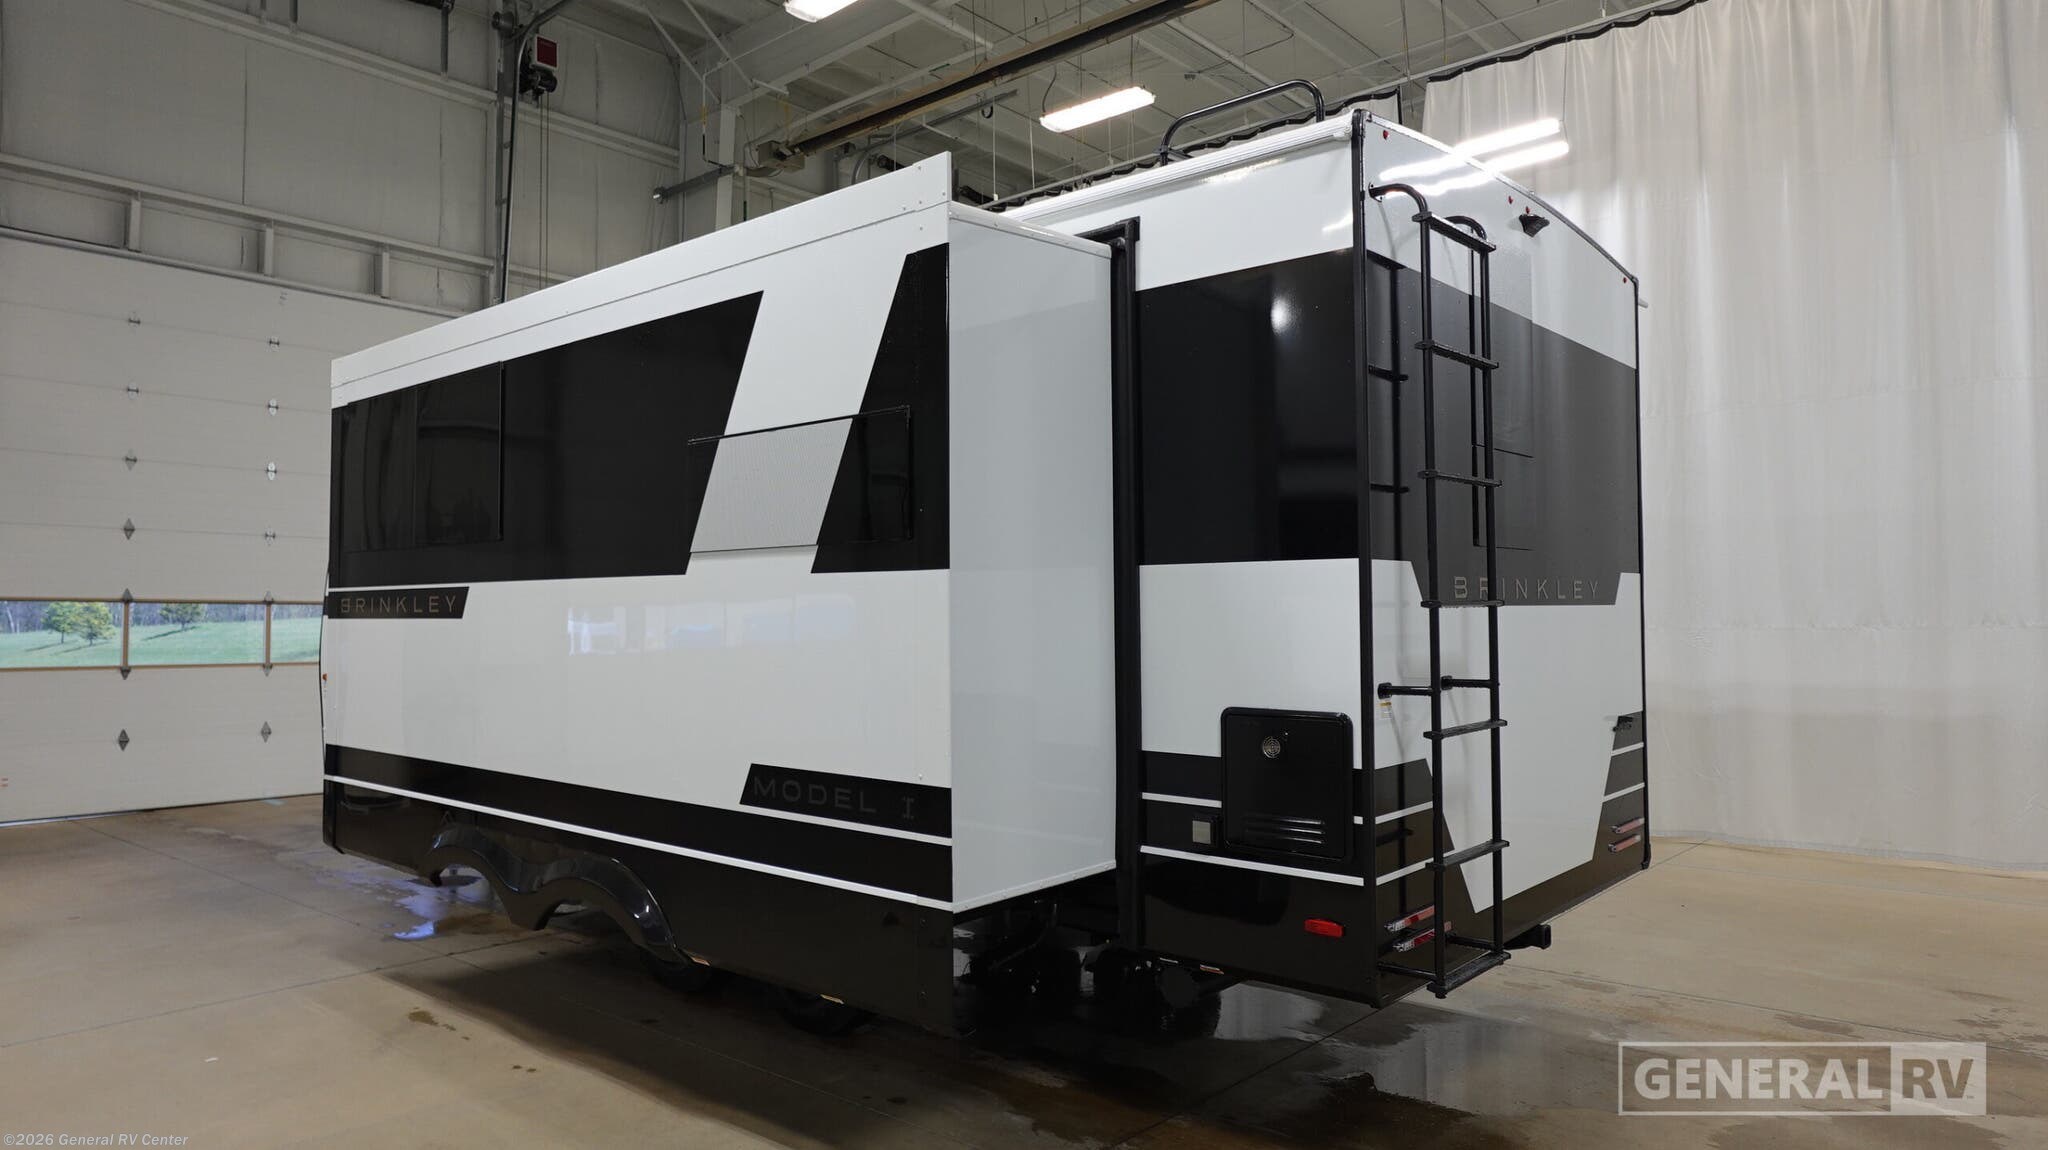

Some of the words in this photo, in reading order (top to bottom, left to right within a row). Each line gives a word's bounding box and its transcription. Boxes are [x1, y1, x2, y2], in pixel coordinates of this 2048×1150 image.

[1454, 576, 1598, 600] BRINKLEY
[340, 595, 457, 613] BRINKLEY
[753, 776, 877, 814] MODEL
